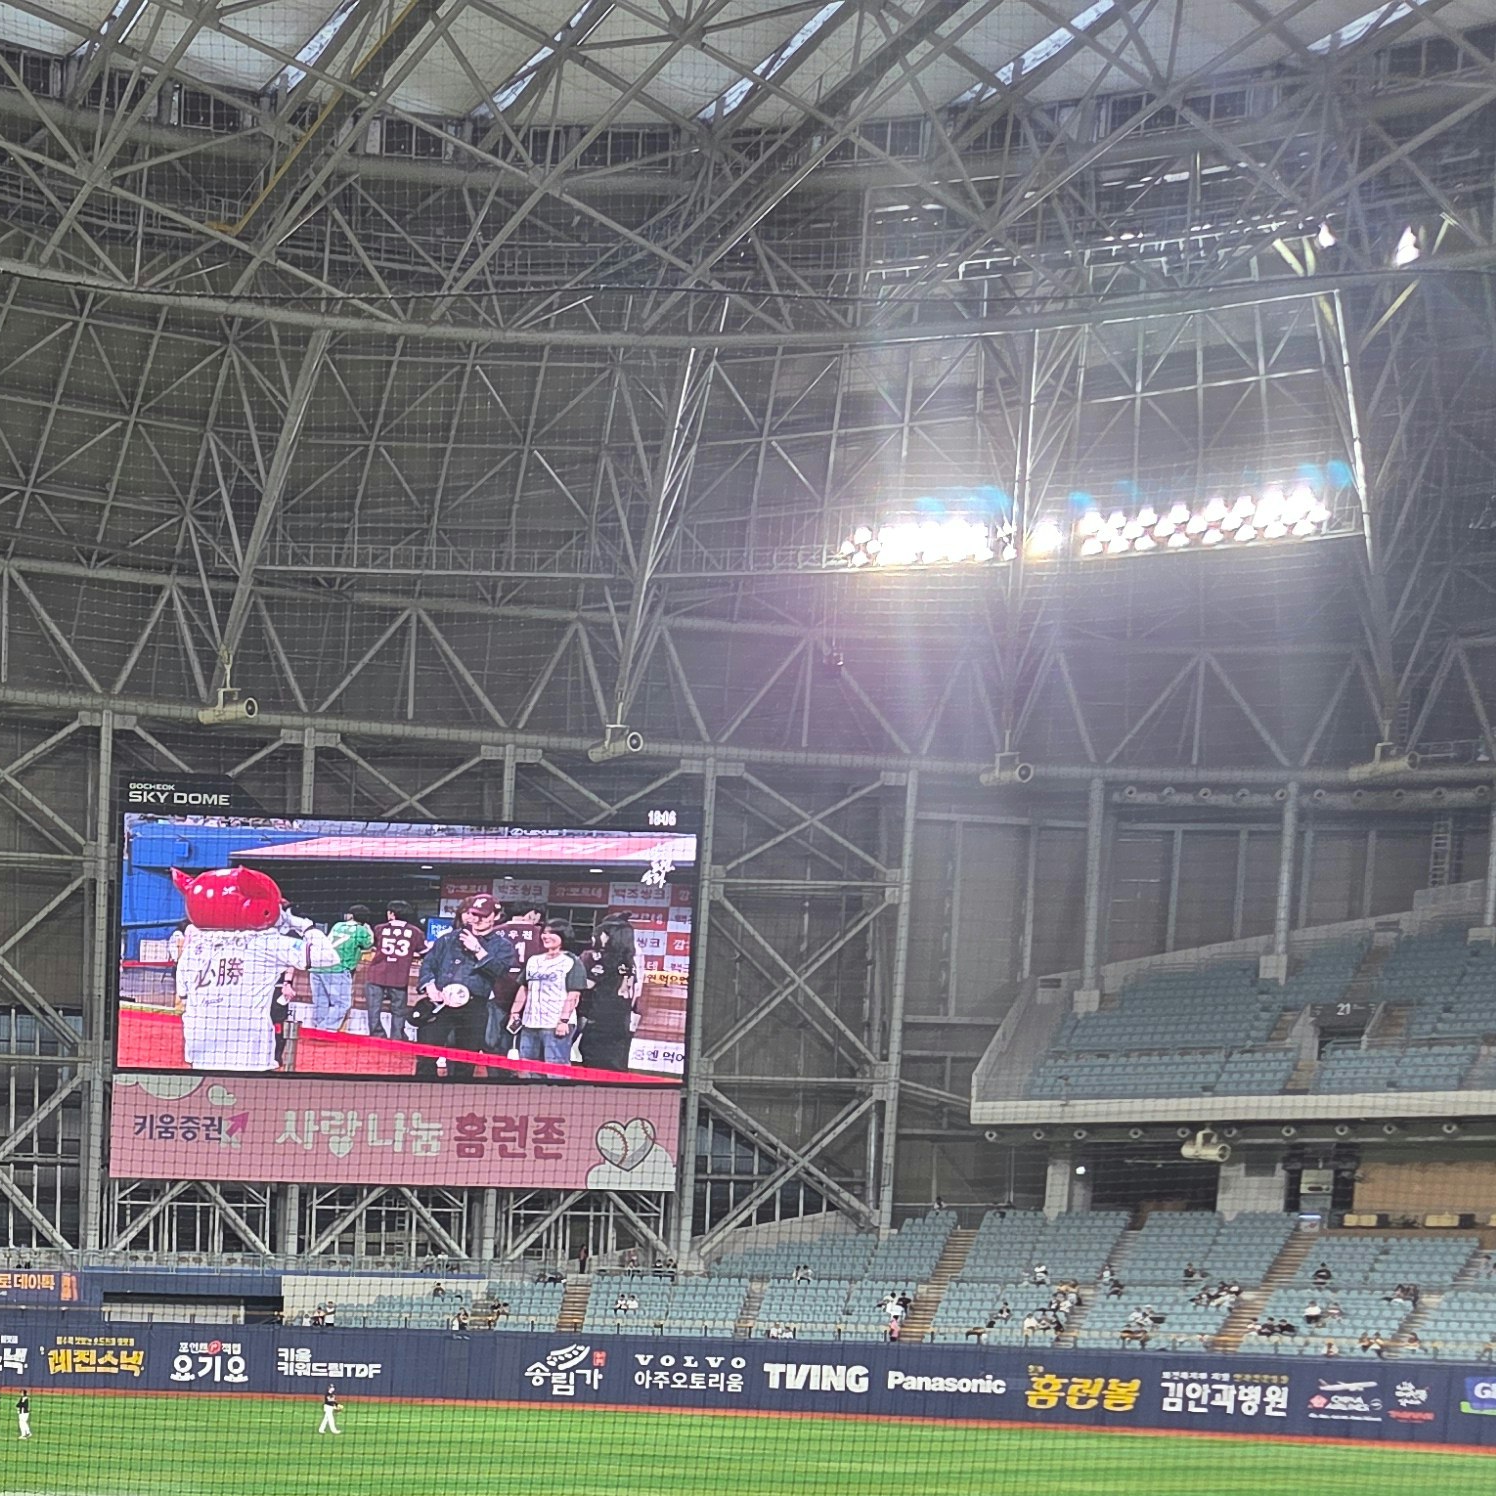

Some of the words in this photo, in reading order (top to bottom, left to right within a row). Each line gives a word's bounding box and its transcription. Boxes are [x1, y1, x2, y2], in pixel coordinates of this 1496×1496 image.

[128, 791, 167, 803] SKY
[173, 793, 231, 806] DOME
[129, 783, 175, 791] GOCHEOK
[647, 810, 676, 826] 18:06
[381, 937, 411, 957] 53
[194, 958, 244, 991] 必勝
[1336, 1002, 1351, 1016] 21
[133, 1113, 224, 1143] 키움증권
[453, 1112, 566, 1160] 홈런존
[47, 1349, 145, 1377] 레전스낵
[277, 1347, 312, 1362] 키움
[635, 1353, 746, 1369] VOLVO
[170, 1354, 249, 1382] 요기요
[524, 1360, 603, 1396] 송림가
[764, 1362, 869, 1393] TVING
[634, 1370, 744, 1393] 아주오토리움
[887, 1371, 1006, 1394] Panasonic
[1025, 1374, 1141, 1411] 홈런볼
[1160, 1382, 1289, 1417] 김안과병원
